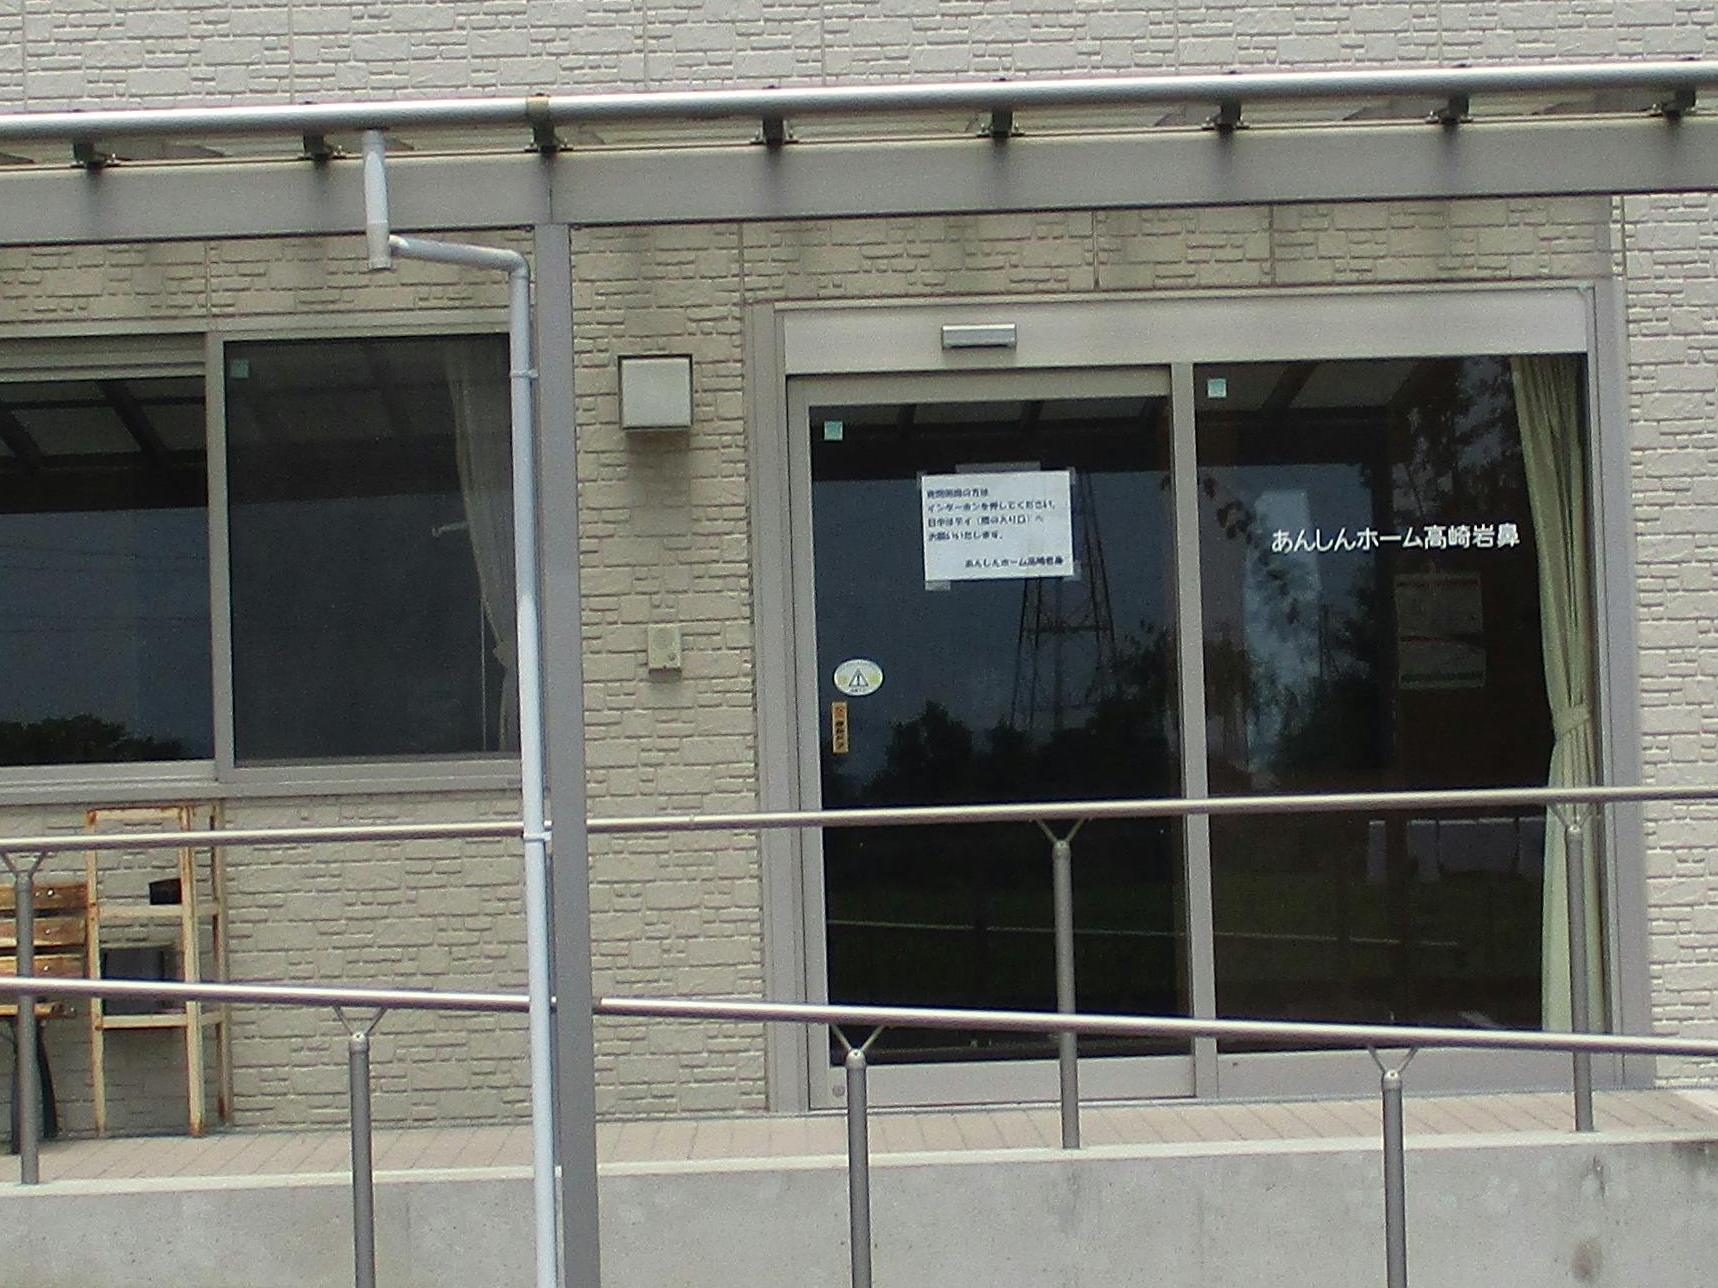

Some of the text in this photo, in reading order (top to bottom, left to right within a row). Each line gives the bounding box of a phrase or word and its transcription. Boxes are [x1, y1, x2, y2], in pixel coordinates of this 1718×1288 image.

[1271, 523, 1520, 554] あんしんホーム高崎岩鼻
